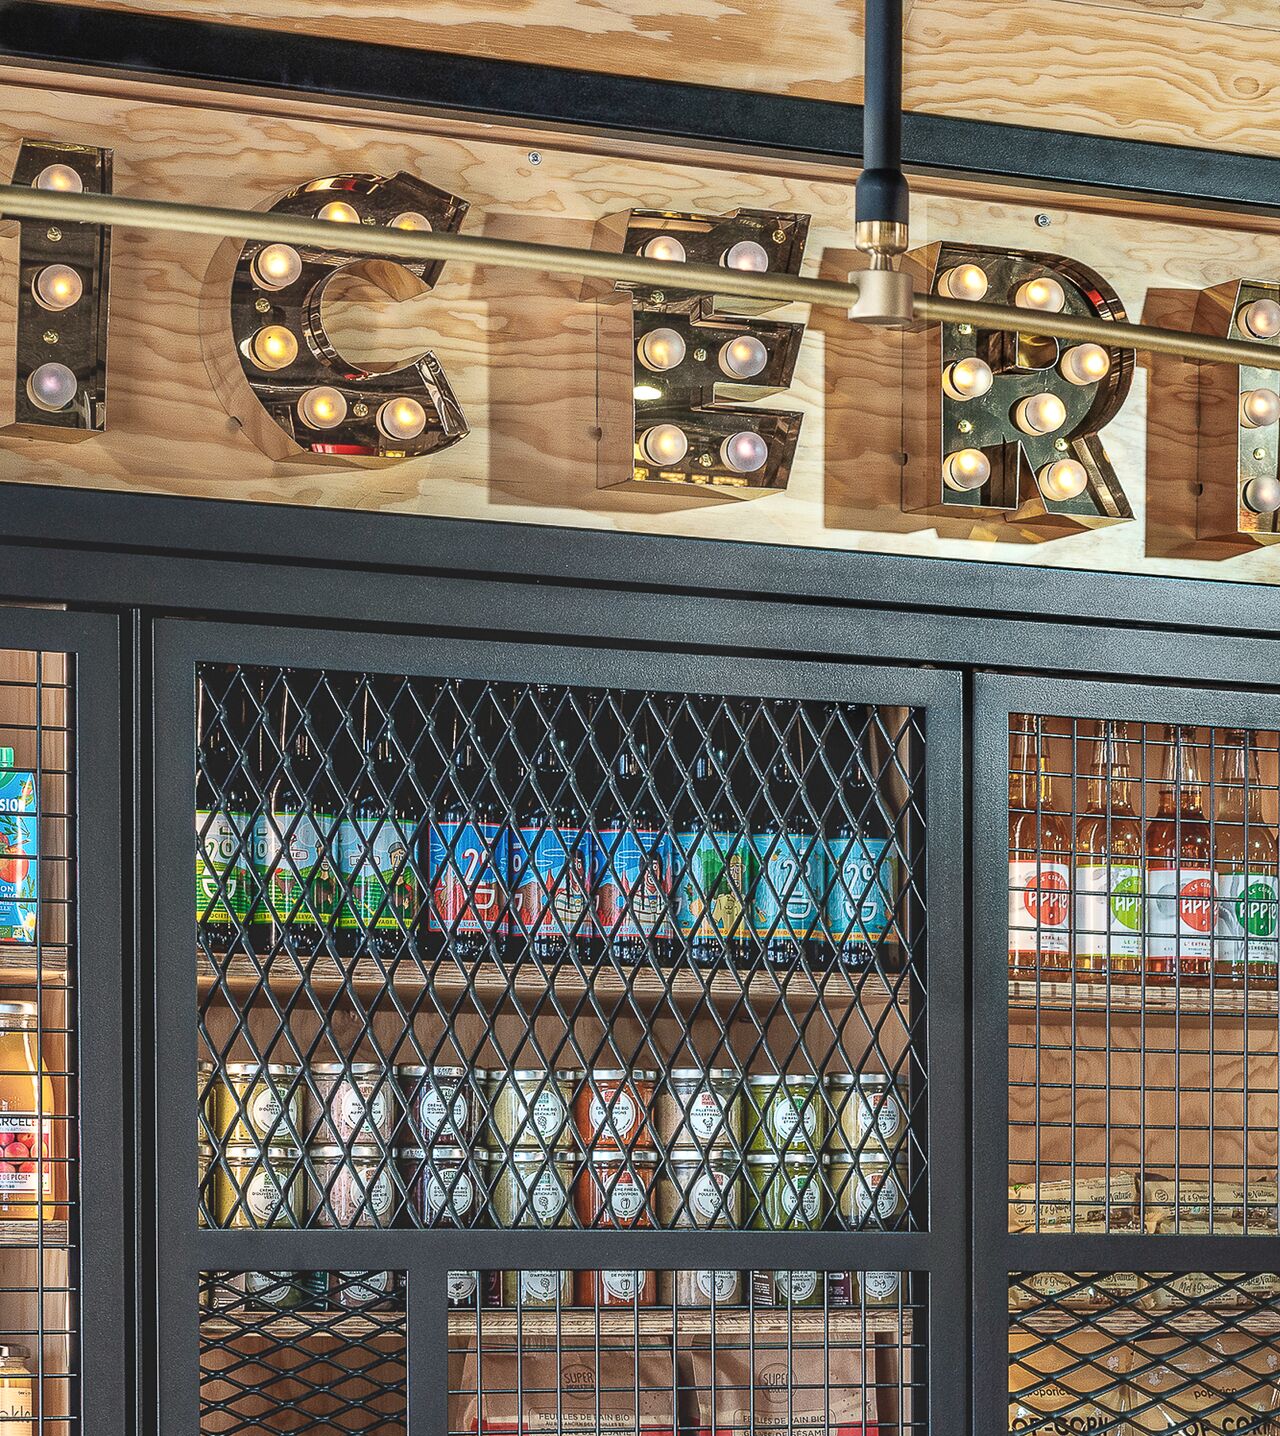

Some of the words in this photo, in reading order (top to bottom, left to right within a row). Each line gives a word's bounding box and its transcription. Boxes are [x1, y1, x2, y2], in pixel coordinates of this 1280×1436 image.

[563, 1372, 594, 1385] SUPER
[580, 1412, 592, 1421] DE
[615, 1414, 630, 1422] BIO
[774, 1417, 786, 1425] DE
